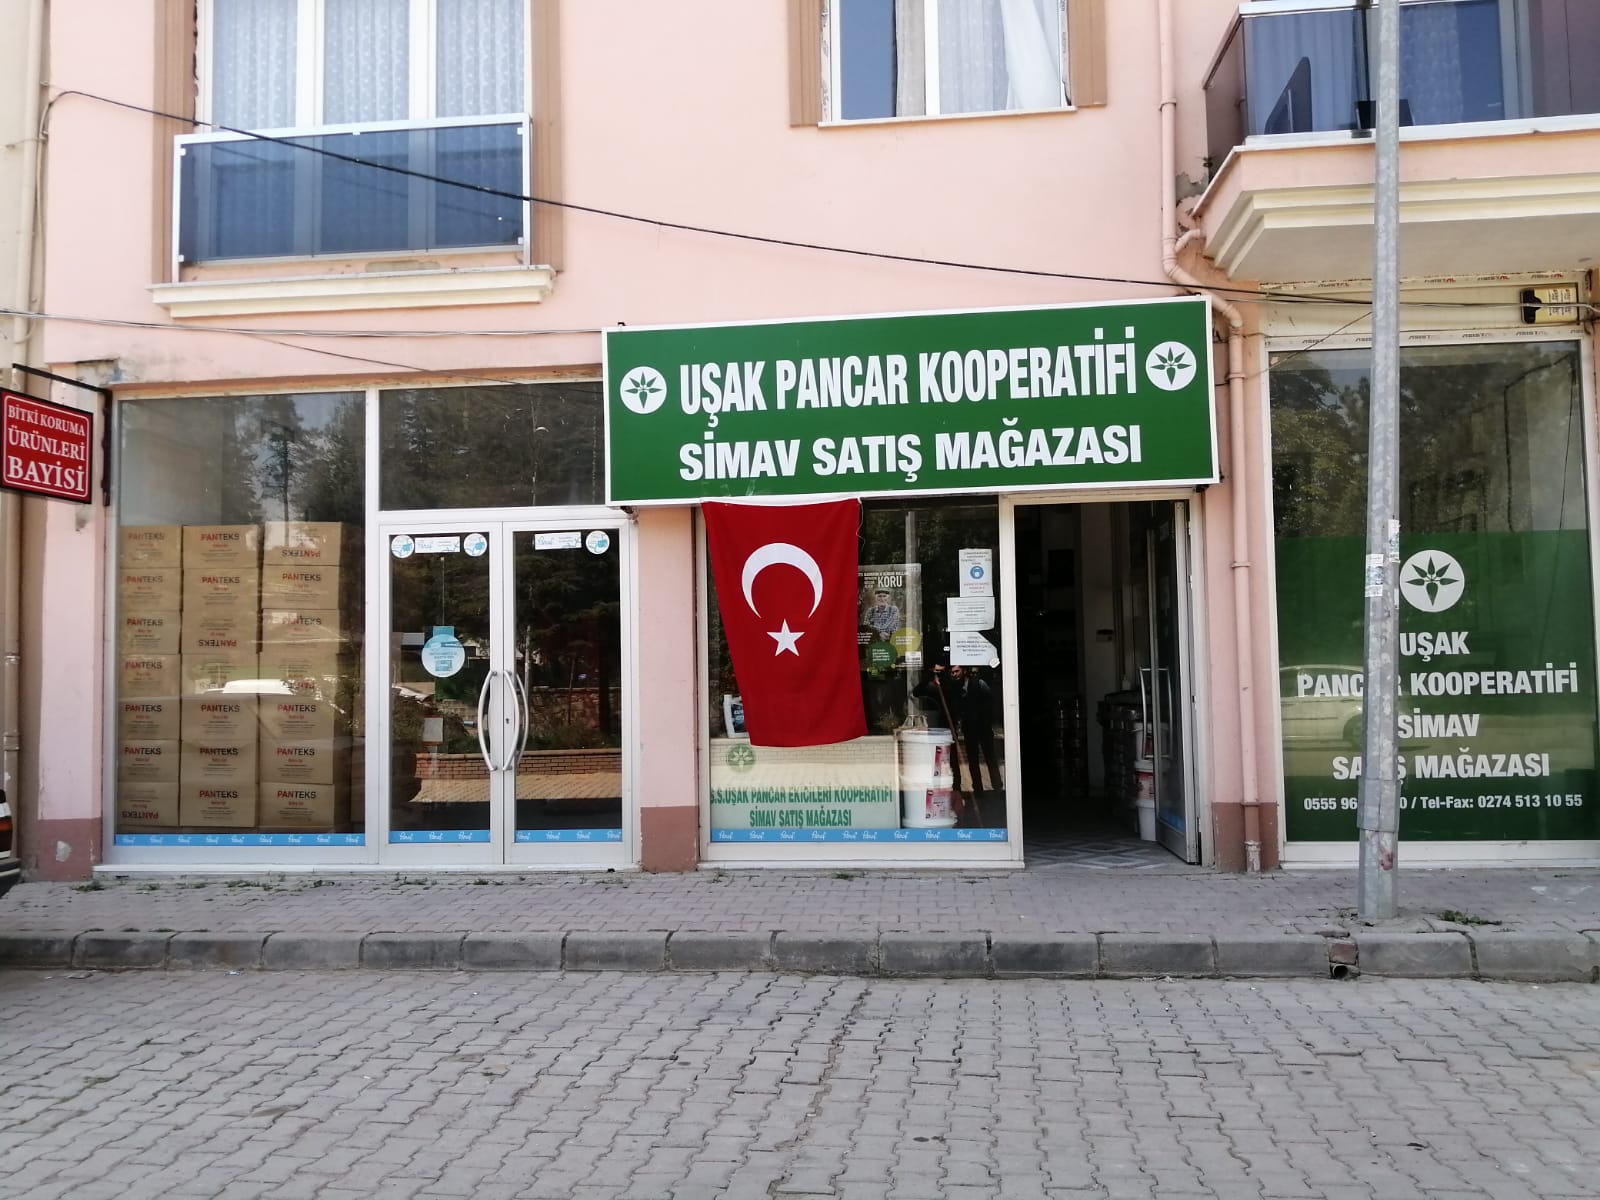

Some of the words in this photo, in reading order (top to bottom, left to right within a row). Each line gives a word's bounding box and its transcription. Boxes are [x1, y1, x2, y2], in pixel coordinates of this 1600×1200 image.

[680, 361, 767, 427] UŞAK
[776, 355, 909, 409] PANCAR
[919, 326, 1136, 403] KOOPERATİFİ
[8, 404, 38, 424] BİTKİ
[40, 414, 85, 436] KORUMA
[8, 425, 85, 460] ÜRÜNLERİ
[680, 431, 800, 481] SİMAV
[812, 434, 923, 482] SATIŞ
[935, 417, 1141, 470] MAĞAZASI
[7, 455, 85, 492] BAYİSİ
[282, 573, 321, 581] PANTEKS
[878, 575, 903, 588] KORU
[127, 618, 163, 626] PANTEKS
[1400, 631, 1471, 662] UŞAK
[1410, 662, 1578, 696] KOOPERATİFİ
[125, 704, 162, 712] PANTEKS
[201, 704, 240, 712] PANTEKS
[278, 704, 317, 712] PANTEKS
[1398, 708, 1480, 739] SİMAV
[124, 747, 162, 755] PANTEKS
[200, 747, 239, 756] PANTEKS
[277, 748, 315, 756] PANTEKS
[1415, 747, 1550, 779] MAĞAZASI
[199, 790, 238, 799] PANTEKS
[277, 790, 317, 799] PANTEKS
[751, 786, 785, 803] PANCAR
[1304, 797, 1337, 811] 0555
[1420, 796, 1474, 810] Tel-Fax:
[1478, 795, 1511, 808] 0274
[1515, 795, 1541, 808] 513
[1545, 795, 1562, 808] 10
[1566, 794, 1583, 808] 55
[122, 811, 159, 819] PANTEKS
[750, 806, 777, 827] SİMAV
[779, 809, 803, 829] SATIŞ
[806, 805, 852, 827] MAĞAZASI
